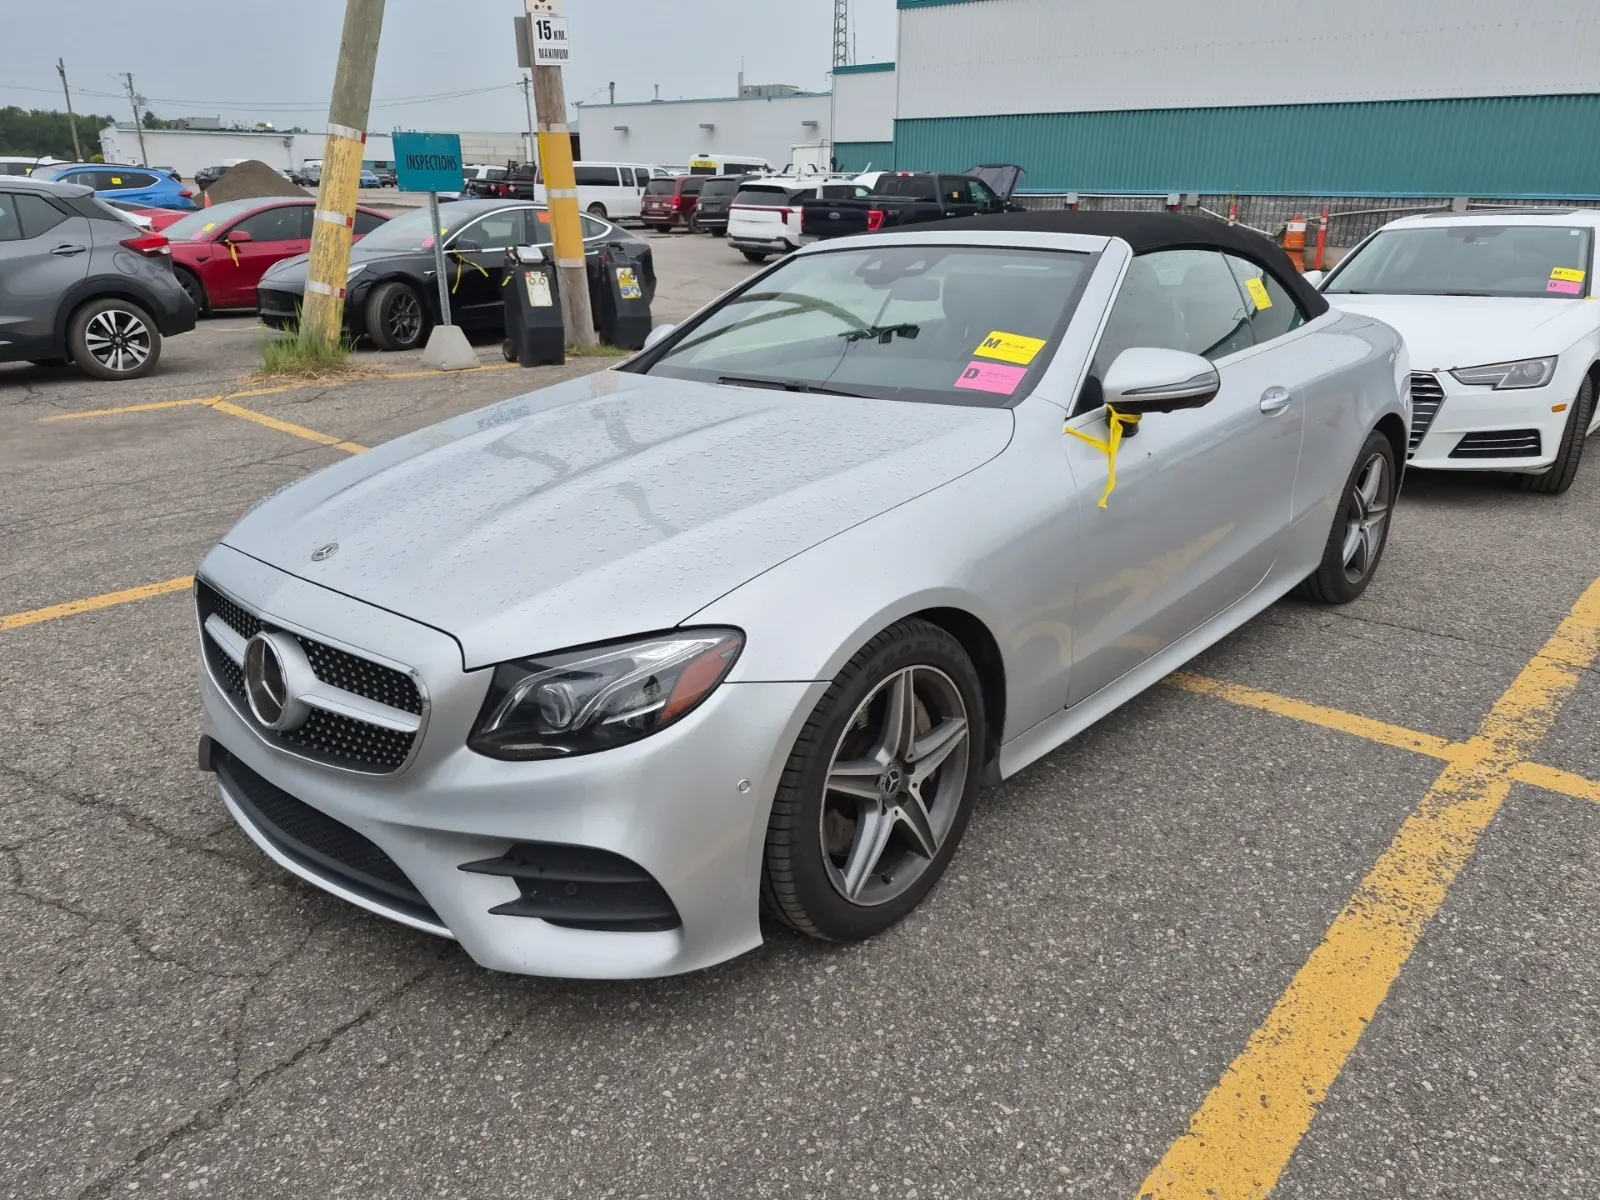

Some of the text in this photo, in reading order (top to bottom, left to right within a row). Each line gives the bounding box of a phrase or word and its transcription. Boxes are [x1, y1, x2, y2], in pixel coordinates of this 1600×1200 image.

[536, 20, 552, 40] 15
[538, 48, 569, 60] MAXIMUM
[405, 154, 458, 171] INSPECTIONS
[983, 337, 1002, 349] M
[963, 367, 980, 379] D
